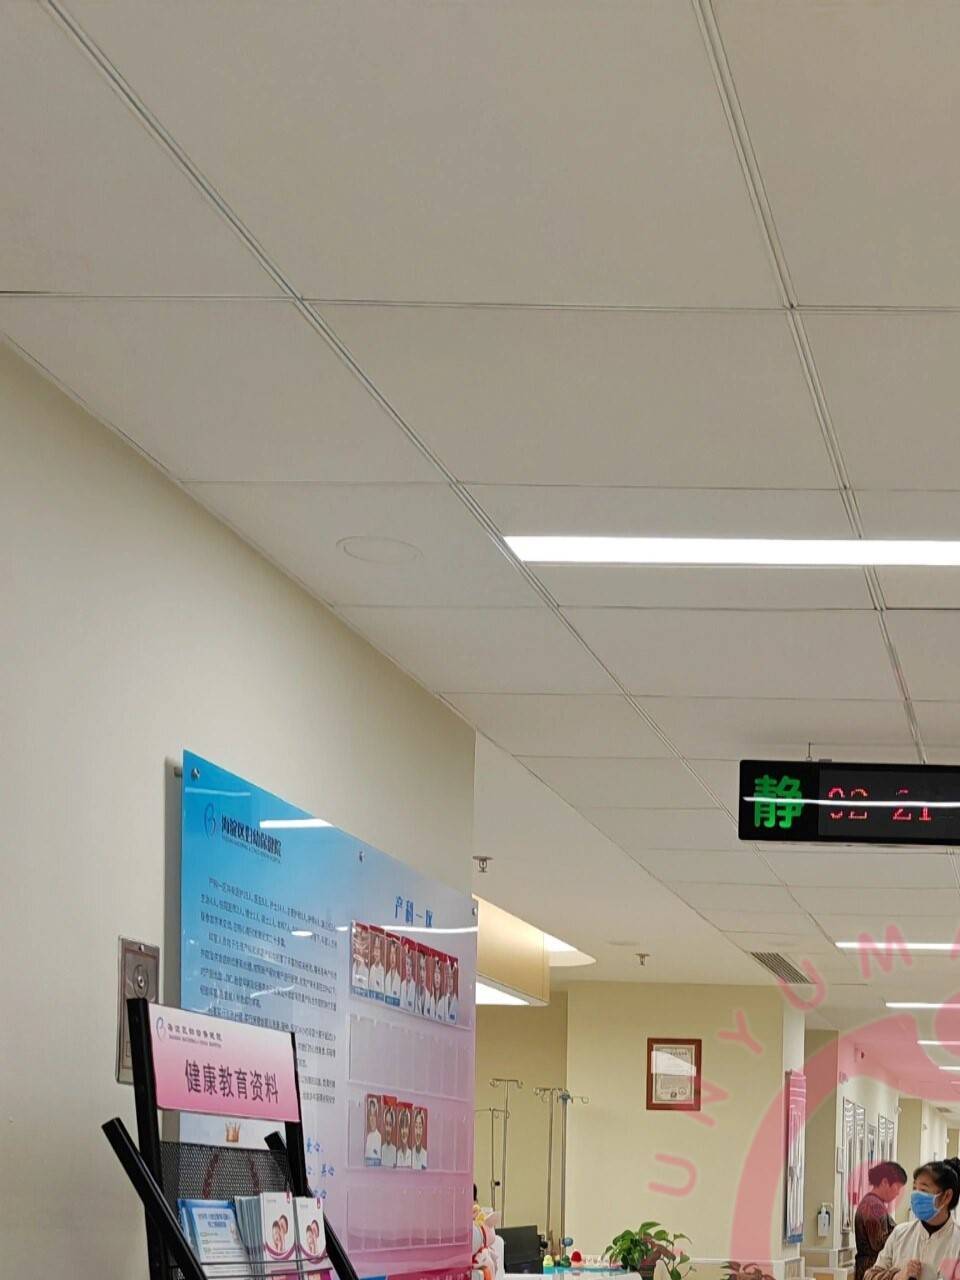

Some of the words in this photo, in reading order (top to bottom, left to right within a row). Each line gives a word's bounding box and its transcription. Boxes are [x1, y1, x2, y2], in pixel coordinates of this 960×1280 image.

[753, 774, 806, 829] 静
[394, 895, 434, 929] 产科一区
[184, 1059, 279, 1104] 健康教育资料
